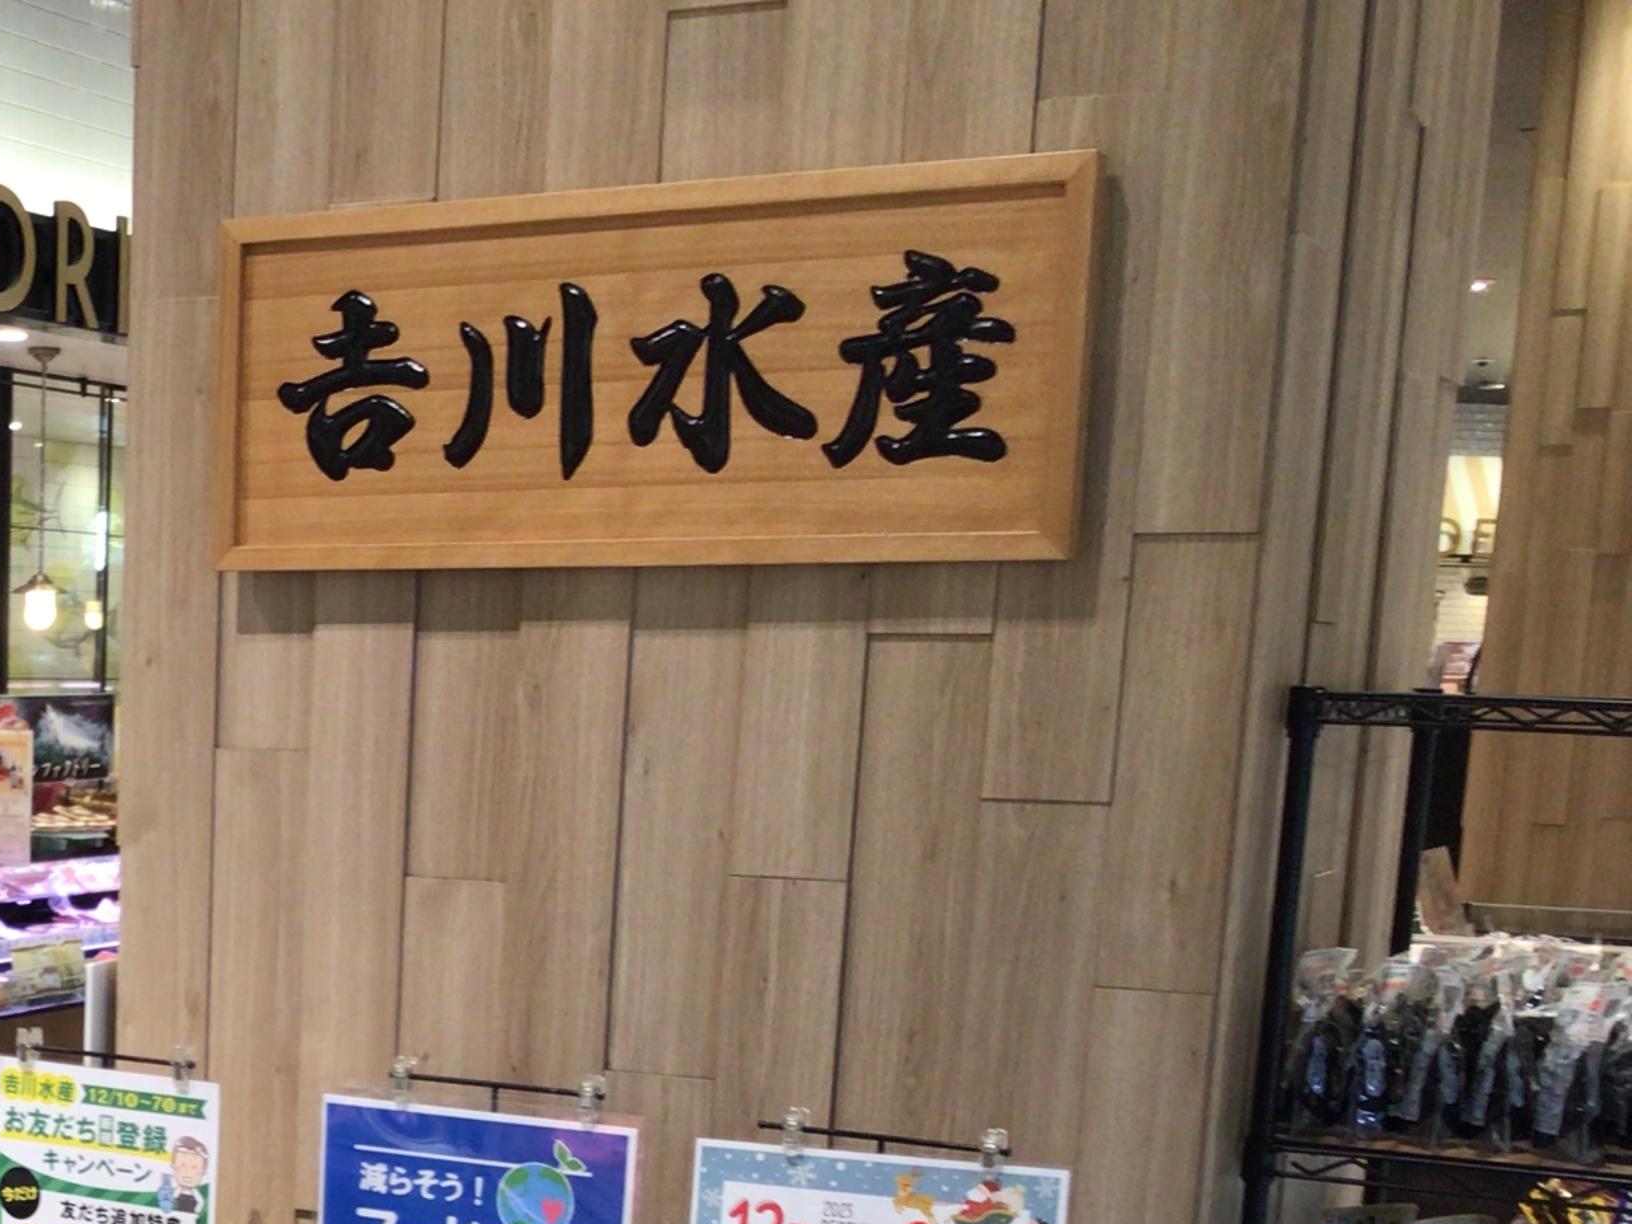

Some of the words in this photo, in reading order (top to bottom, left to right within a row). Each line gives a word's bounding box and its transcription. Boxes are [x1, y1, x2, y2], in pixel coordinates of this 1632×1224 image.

[43, 1150, 153, 1183] キャンペーン
[359, 1162, 484, 1207] 減らそう!
